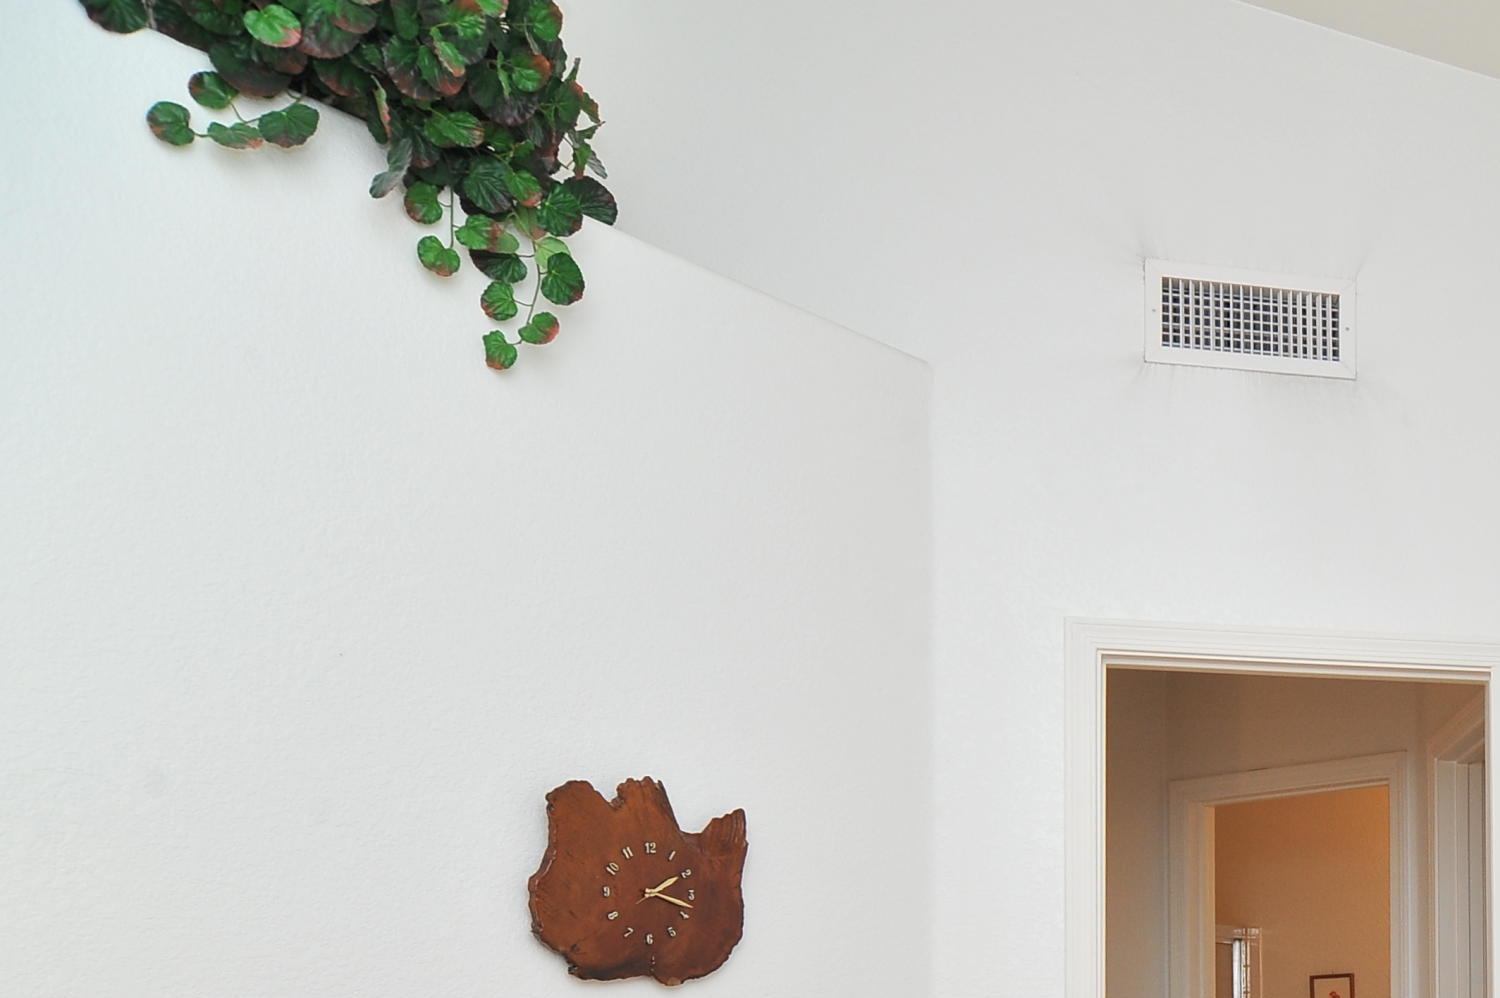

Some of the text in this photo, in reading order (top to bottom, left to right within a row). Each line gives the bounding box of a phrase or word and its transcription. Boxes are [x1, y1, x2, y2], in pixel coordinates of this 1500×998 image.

[623, 846, 634, 859] 11
[645, 842, 656, 853] 12
[669, 851, 676, 861] 1
[606, 862, 619, 875] 10
[681, 869, 692, 878] 2
[603, 886, 610, 896] 9
[689, 889, 695, 900] 3
[608, 911, 618, 920] 8
[680, 911, 690, 919] 4
[624, 927, 634, 937] 7
[668, 927, 677, 936] 5
[646, 934, 653, 944] 6
